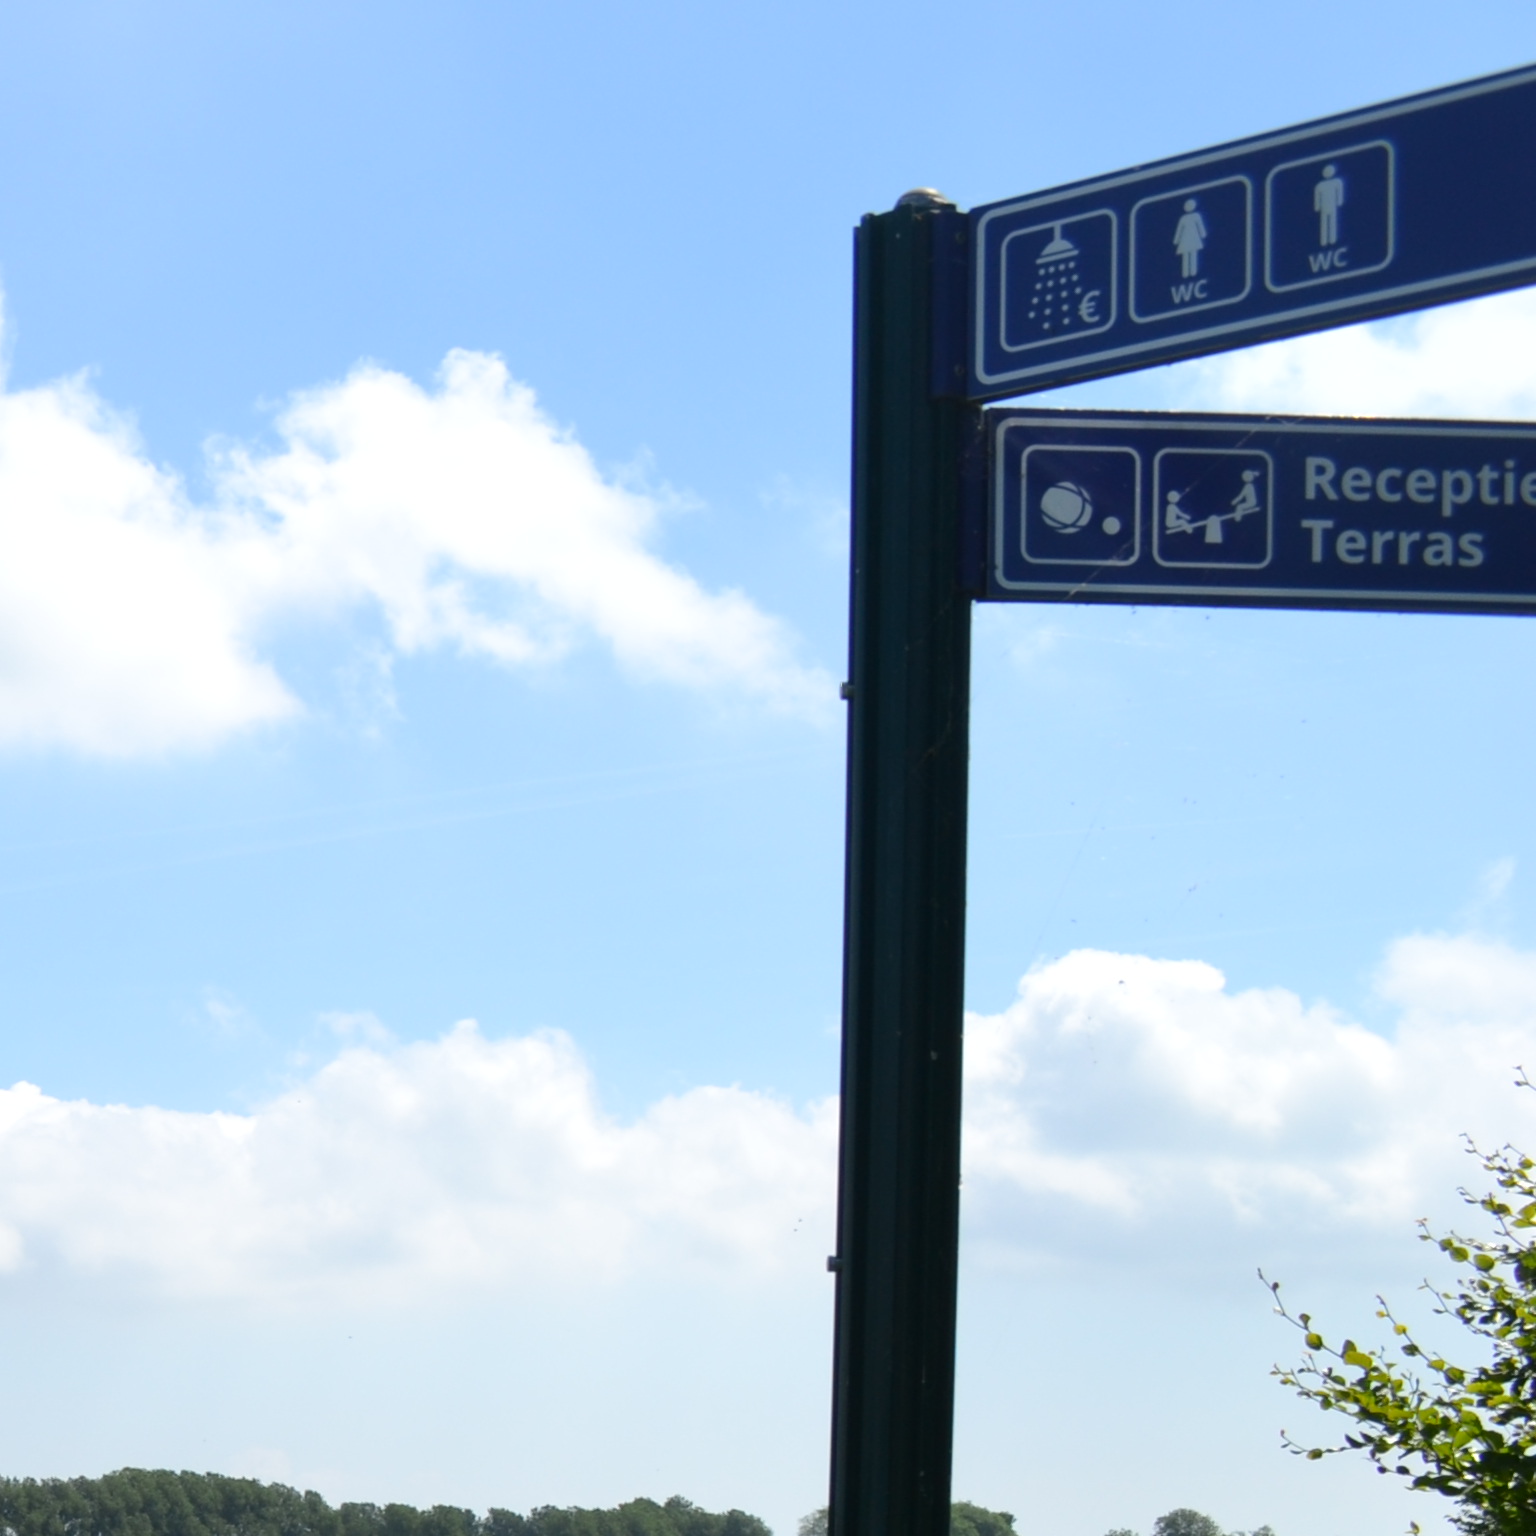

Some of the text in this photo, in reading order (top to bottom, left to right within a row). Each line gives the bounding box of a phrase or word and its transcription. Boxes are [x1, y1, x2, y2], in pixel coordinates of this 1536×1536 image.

[1308, 247, 1348, 274] WC
[1170, 278, 1208, 305] WC
[1304, 455, 1536, 518] Receptie
[1300, 518, 1485, 568] Terras
